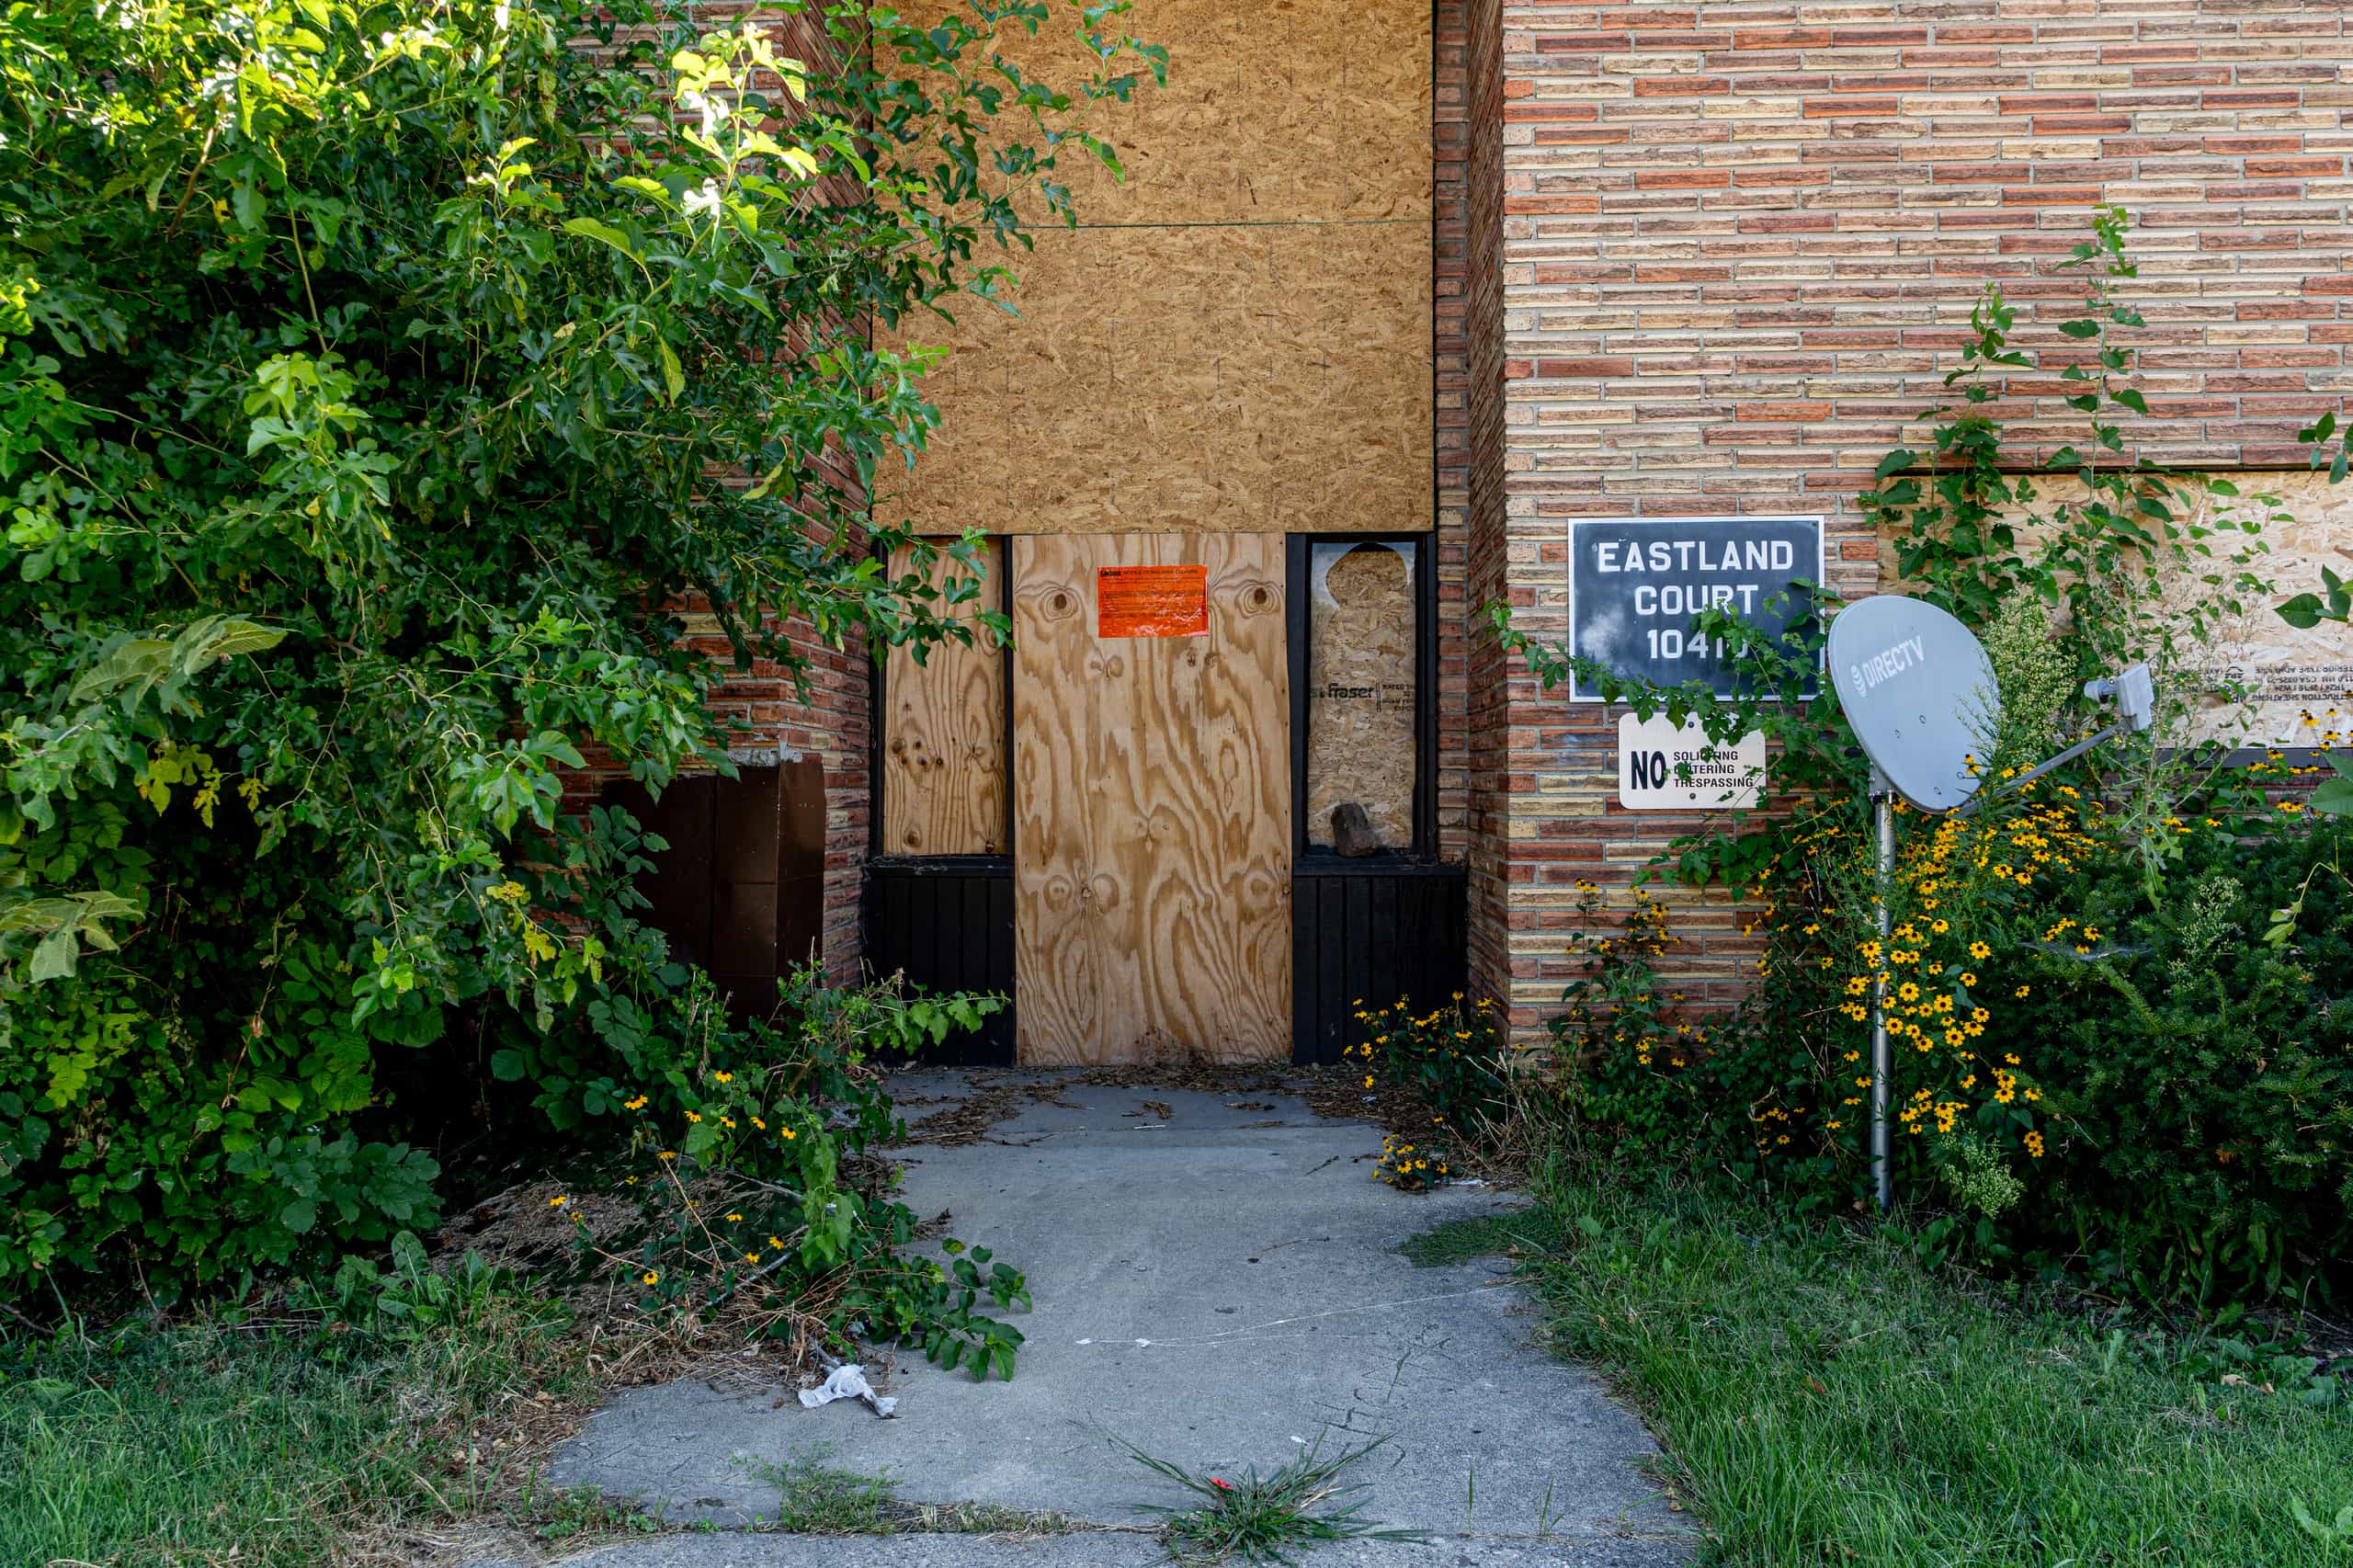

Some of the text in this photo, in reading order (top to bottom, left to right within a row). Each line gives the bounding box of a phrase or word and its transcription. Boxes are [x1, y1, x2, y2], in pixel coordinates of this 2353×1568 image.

[1597, 540, 1794, 573] EASTLAND
[1634, 585, 1759, 616] COURT
[1861, 634, 1925, 688] DIRECTV
[1631, 750, 1667, 790] NO
[1674, 778, 1754, 788] TRESPASSING
